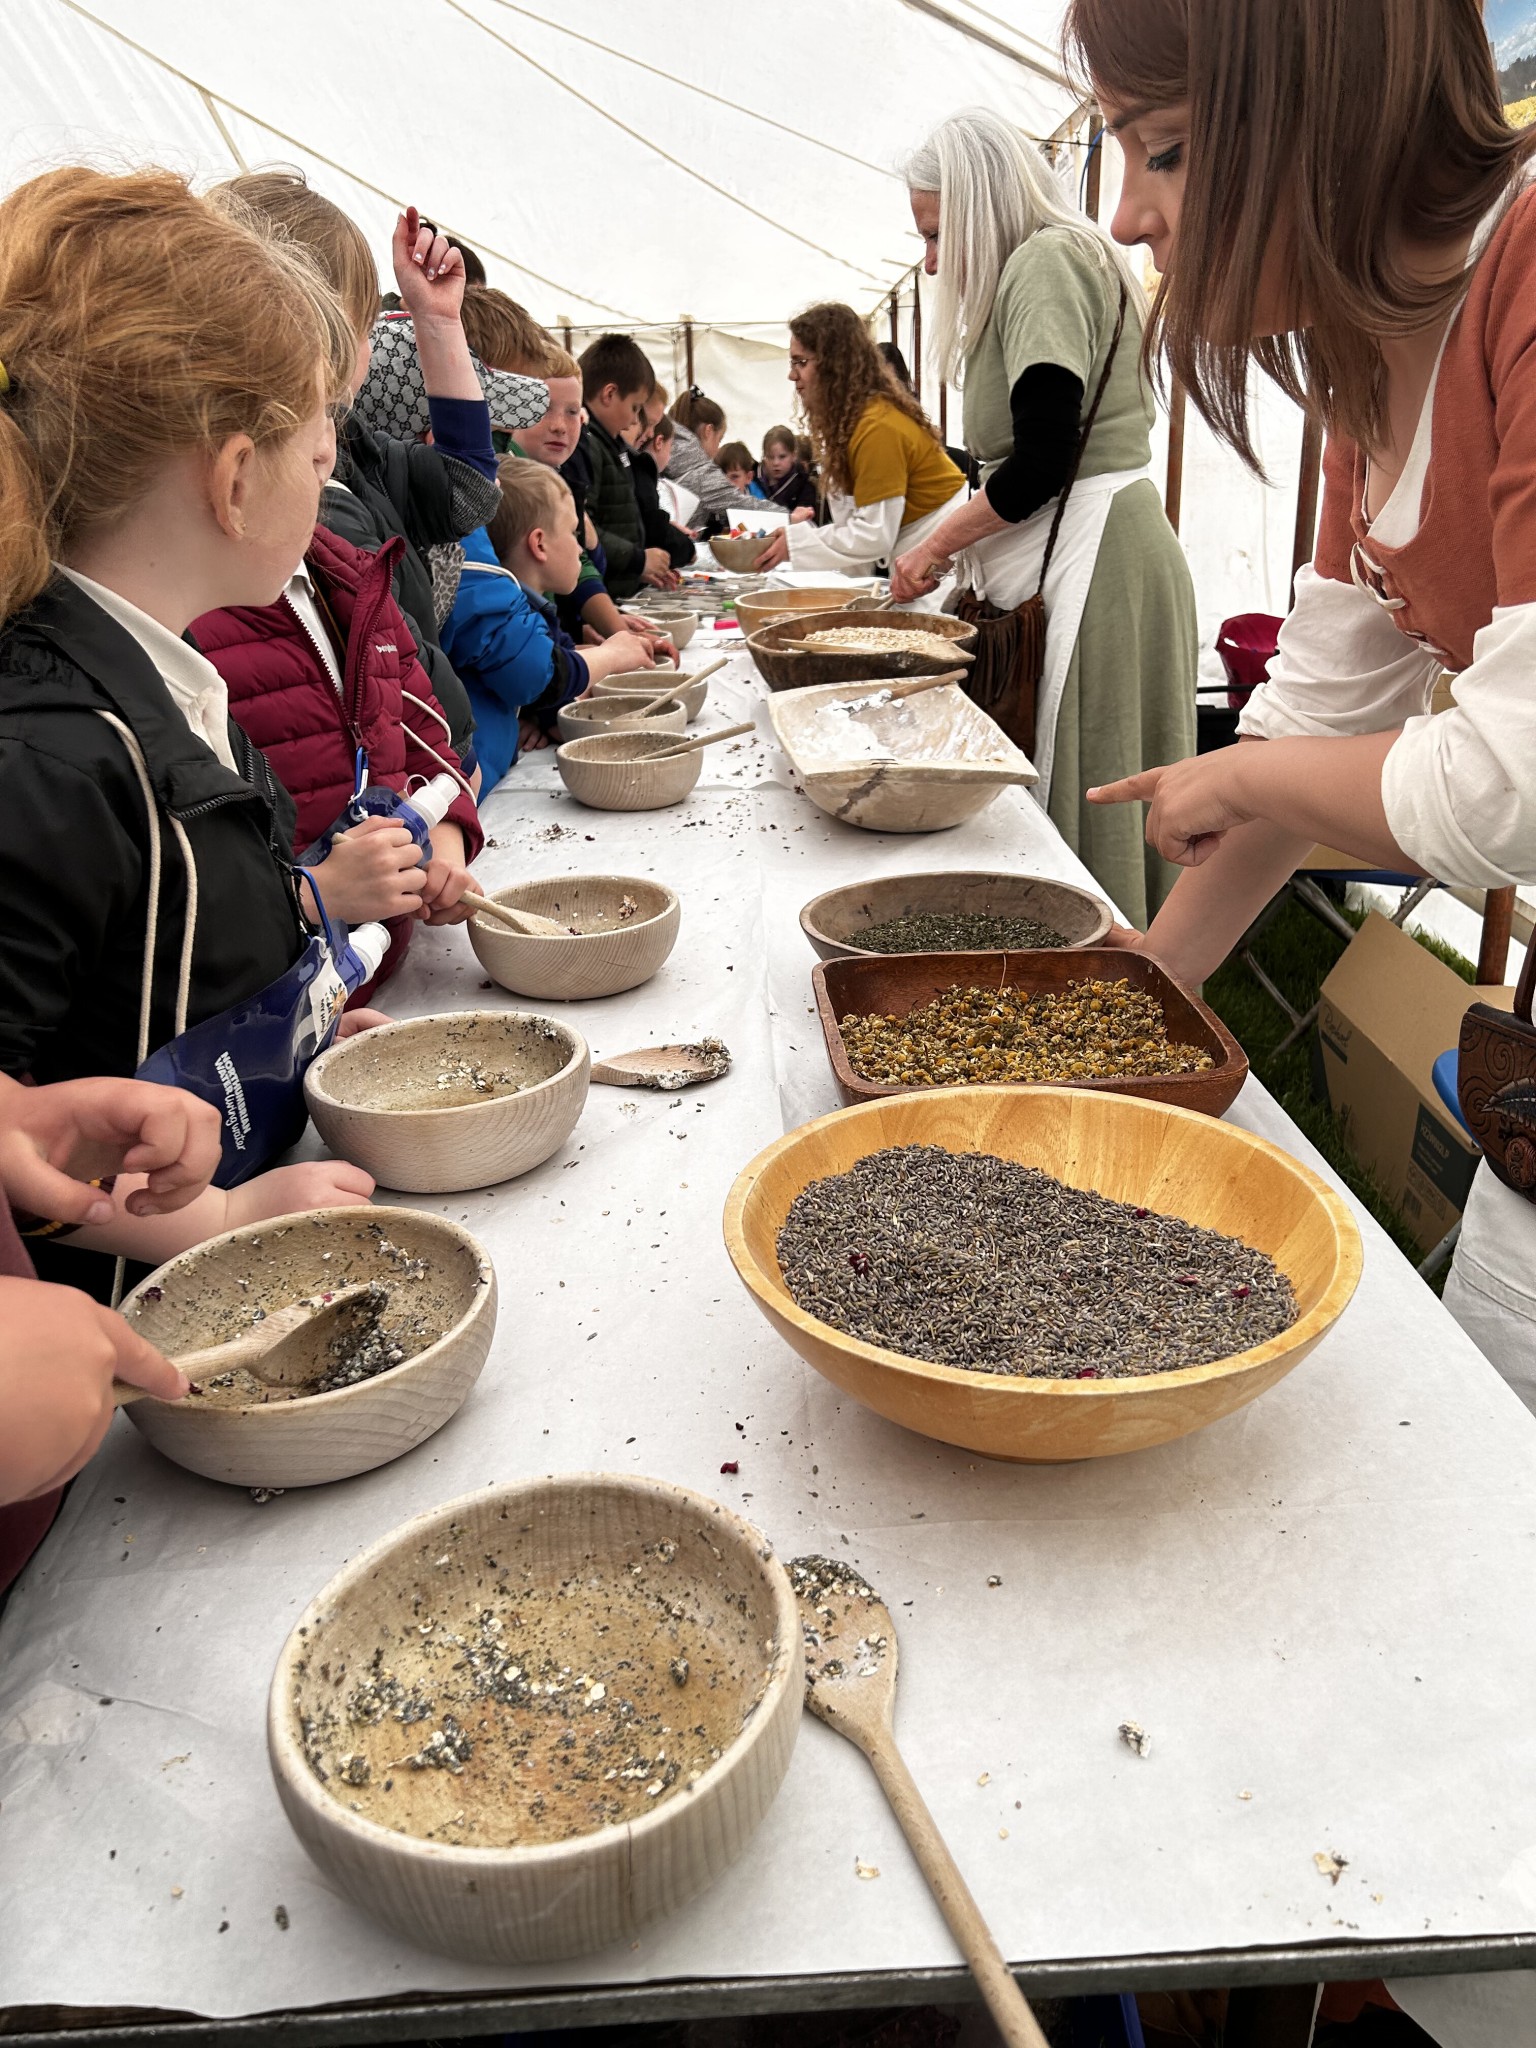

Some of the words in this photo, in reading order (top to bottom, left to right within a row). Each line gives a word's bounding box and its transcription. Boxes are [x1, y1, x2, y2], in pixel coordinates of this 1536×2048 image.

[214, 1057, 234, 1095] WATER
[224, 1093, 238, 1127] living
[231, 1122, 246, 1151] water
[220, 1051, 252, 1134] NORTHUMBRIAN
